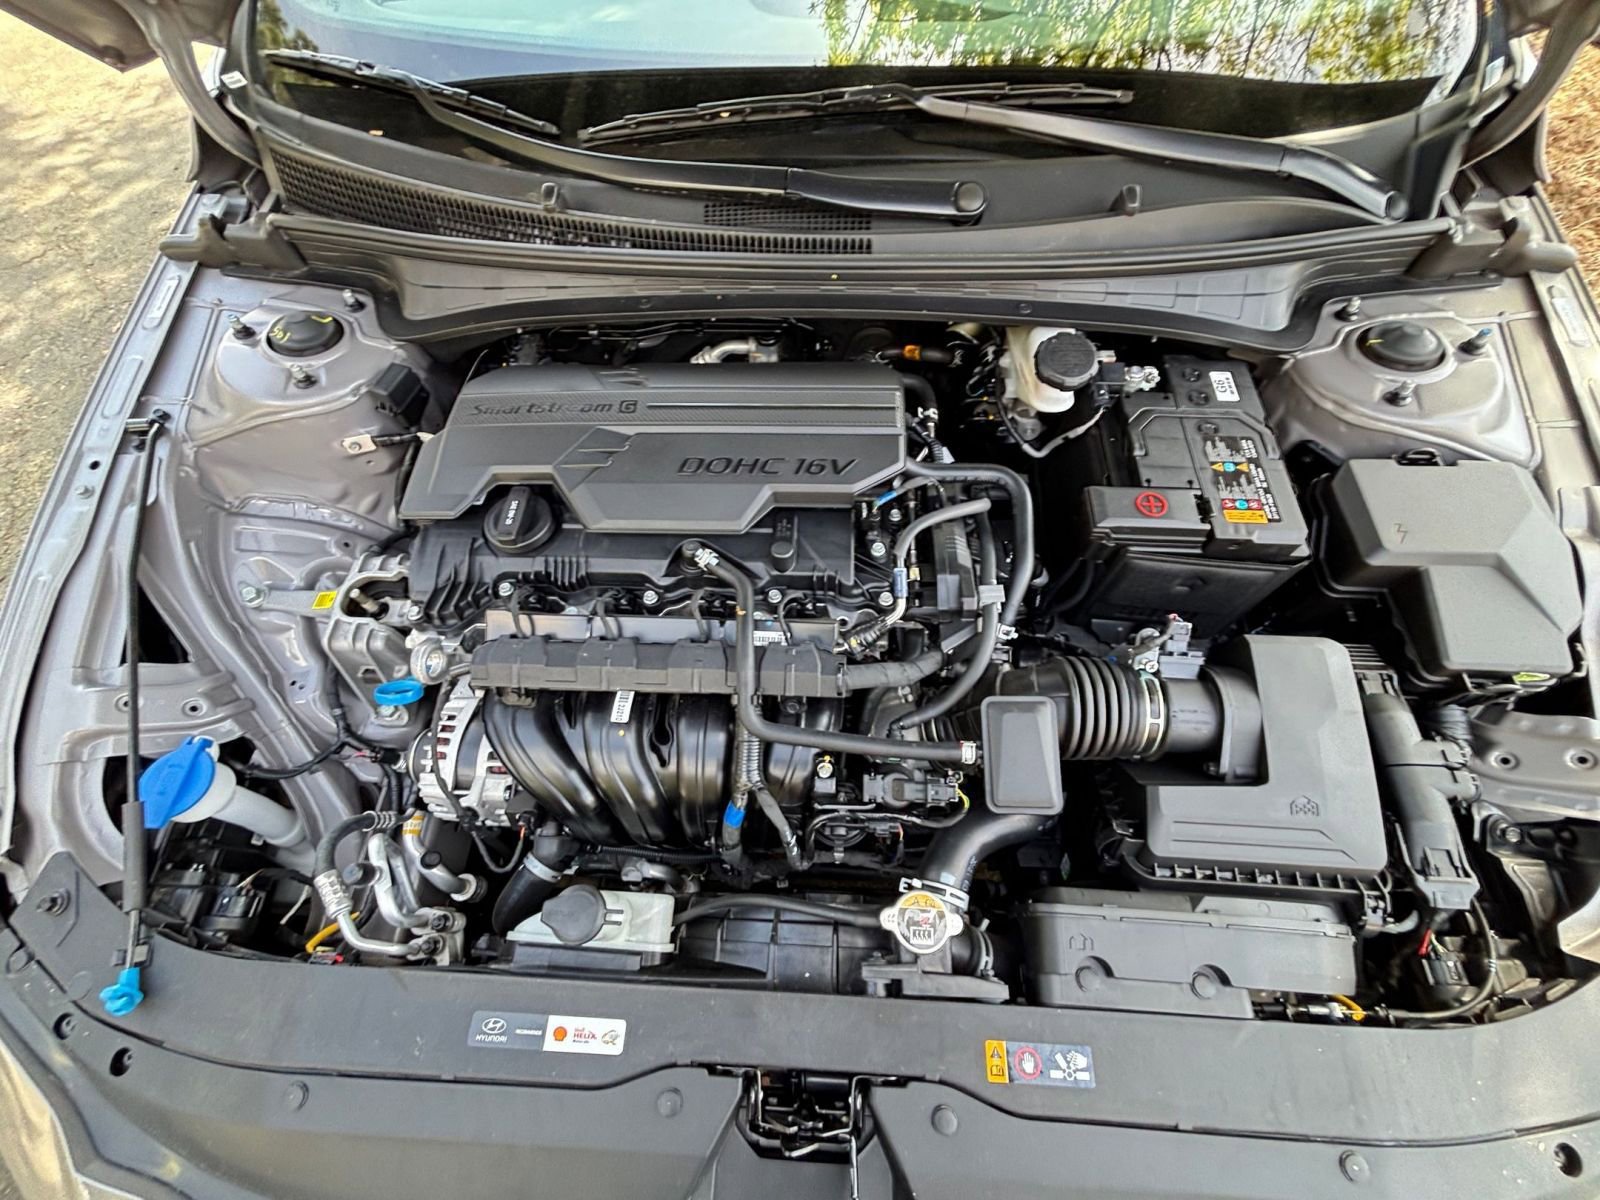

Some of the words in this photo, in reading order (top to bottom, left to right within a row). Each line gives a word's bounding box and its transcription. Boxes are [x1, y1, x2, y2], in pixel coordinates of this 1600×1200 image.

[677, 457, 787, 475] DOHC
[794, 458, 858, 475] 16V
[475, 1034, 508, 1044] HYUNDAI
